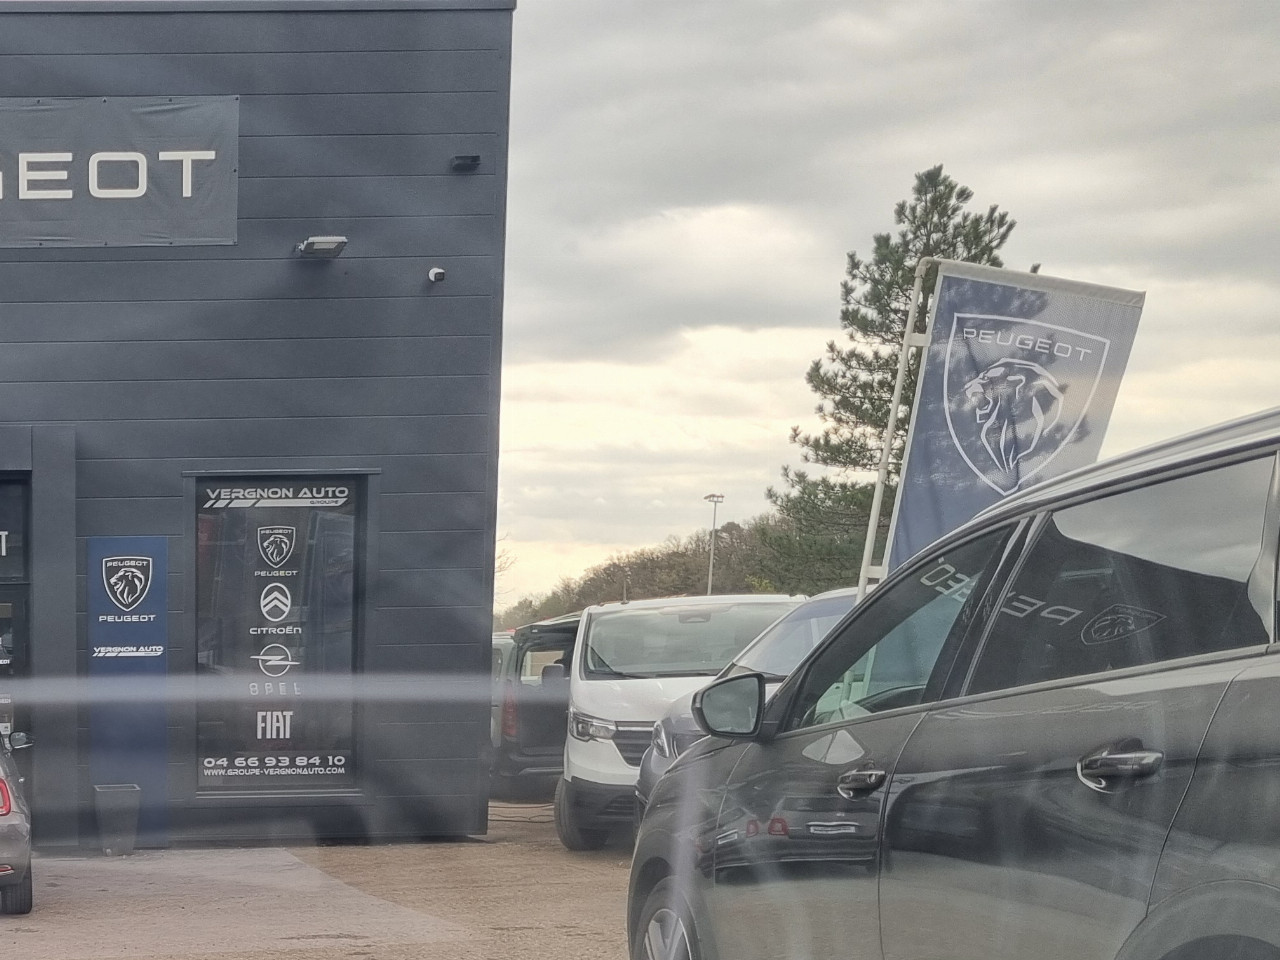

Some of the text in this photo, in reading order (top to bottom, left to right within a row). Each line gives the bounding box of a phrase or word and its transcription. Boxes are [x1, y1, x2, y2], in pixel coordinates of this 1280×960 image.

[963, 328, 1092, 361] PEUGEOT
[206, 487, 349, 499] VERGNON AUTO
[98, 614, 157, 622] PEUGEOT
[249, 682, 301, 696] OPEL
[256, 711, 293, 739] FIAT
[203, 755, 346, 767] 04 66 93 84 10
[203, 767, 346, 776] WWW.GROUPE-VERGNONAUTO.COM
